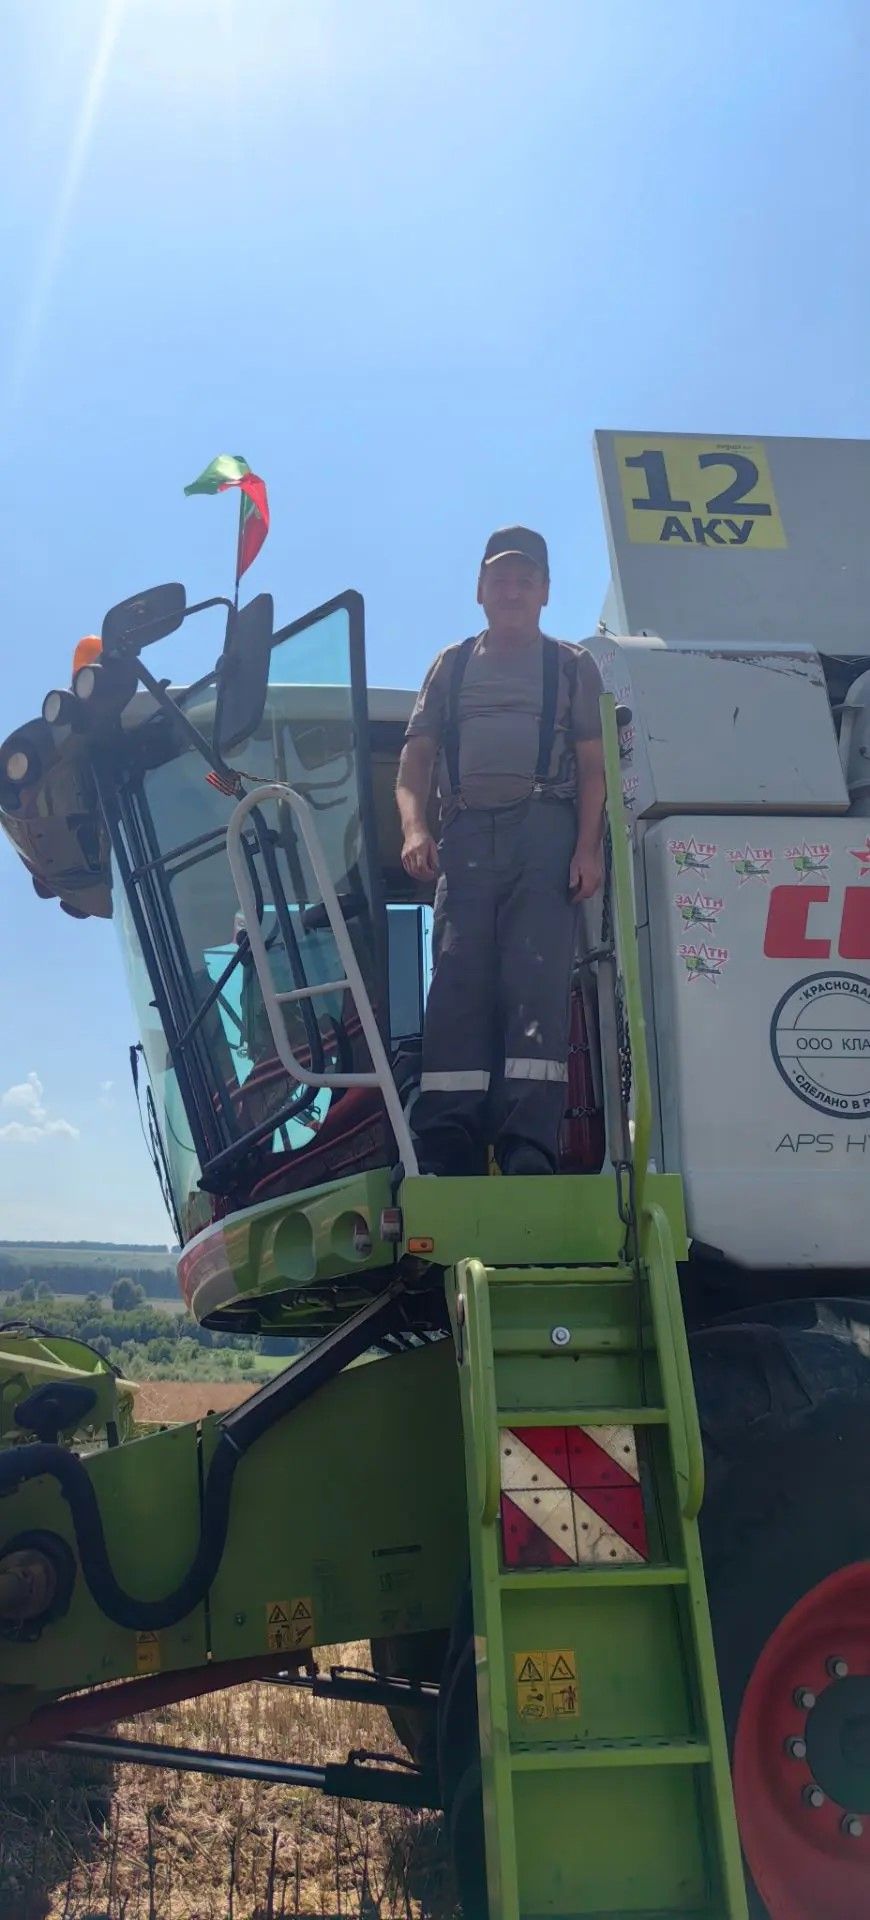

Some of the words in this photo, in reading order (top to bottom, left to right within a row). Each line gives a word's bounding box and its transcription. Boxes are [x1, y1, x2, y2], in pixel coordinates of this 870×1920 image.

[624, 450, 772, 516] 12
[659, 516, 754, 545] АКУ
[802, 981, 870, 1001] КРАСНОДА
[796, 1037, 833, 1051] ООО
[795, 1074, 849, 1109] СДЕЛАНО
[852, 1099, 860, 1109] В
[775, 1133, 834, 1153] APS
[846, 1133, 870, 1153] H
